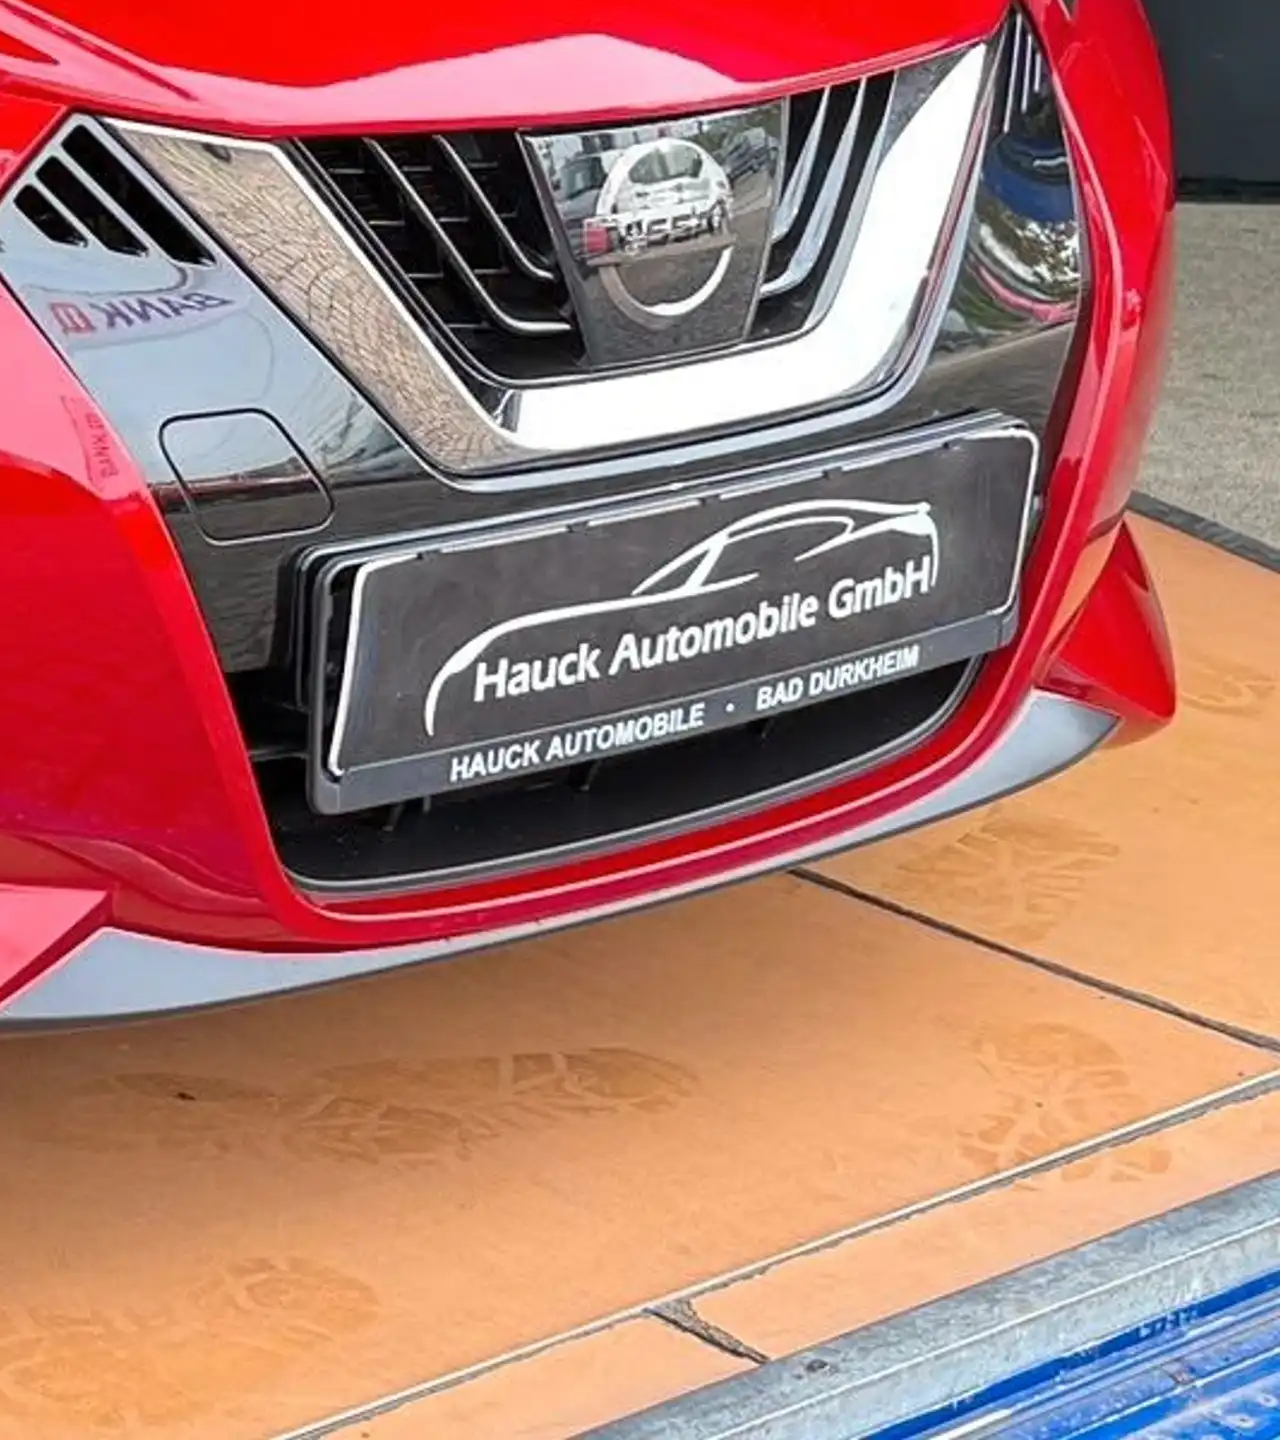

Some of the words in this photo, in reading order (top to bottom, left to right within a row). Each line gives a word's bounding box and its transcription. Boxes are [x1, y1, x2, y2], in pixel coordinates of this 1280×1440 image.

[473, 643, 601, 703] Hauck
[608, 592, 820, 676] Automobile
[827, 554, 932, 619] GmbH
[449, 739, 541, 772] HAUCK
[544, 702, 706, 761] AUTOMOBILE
[755, 675, 804, 711] BAD
